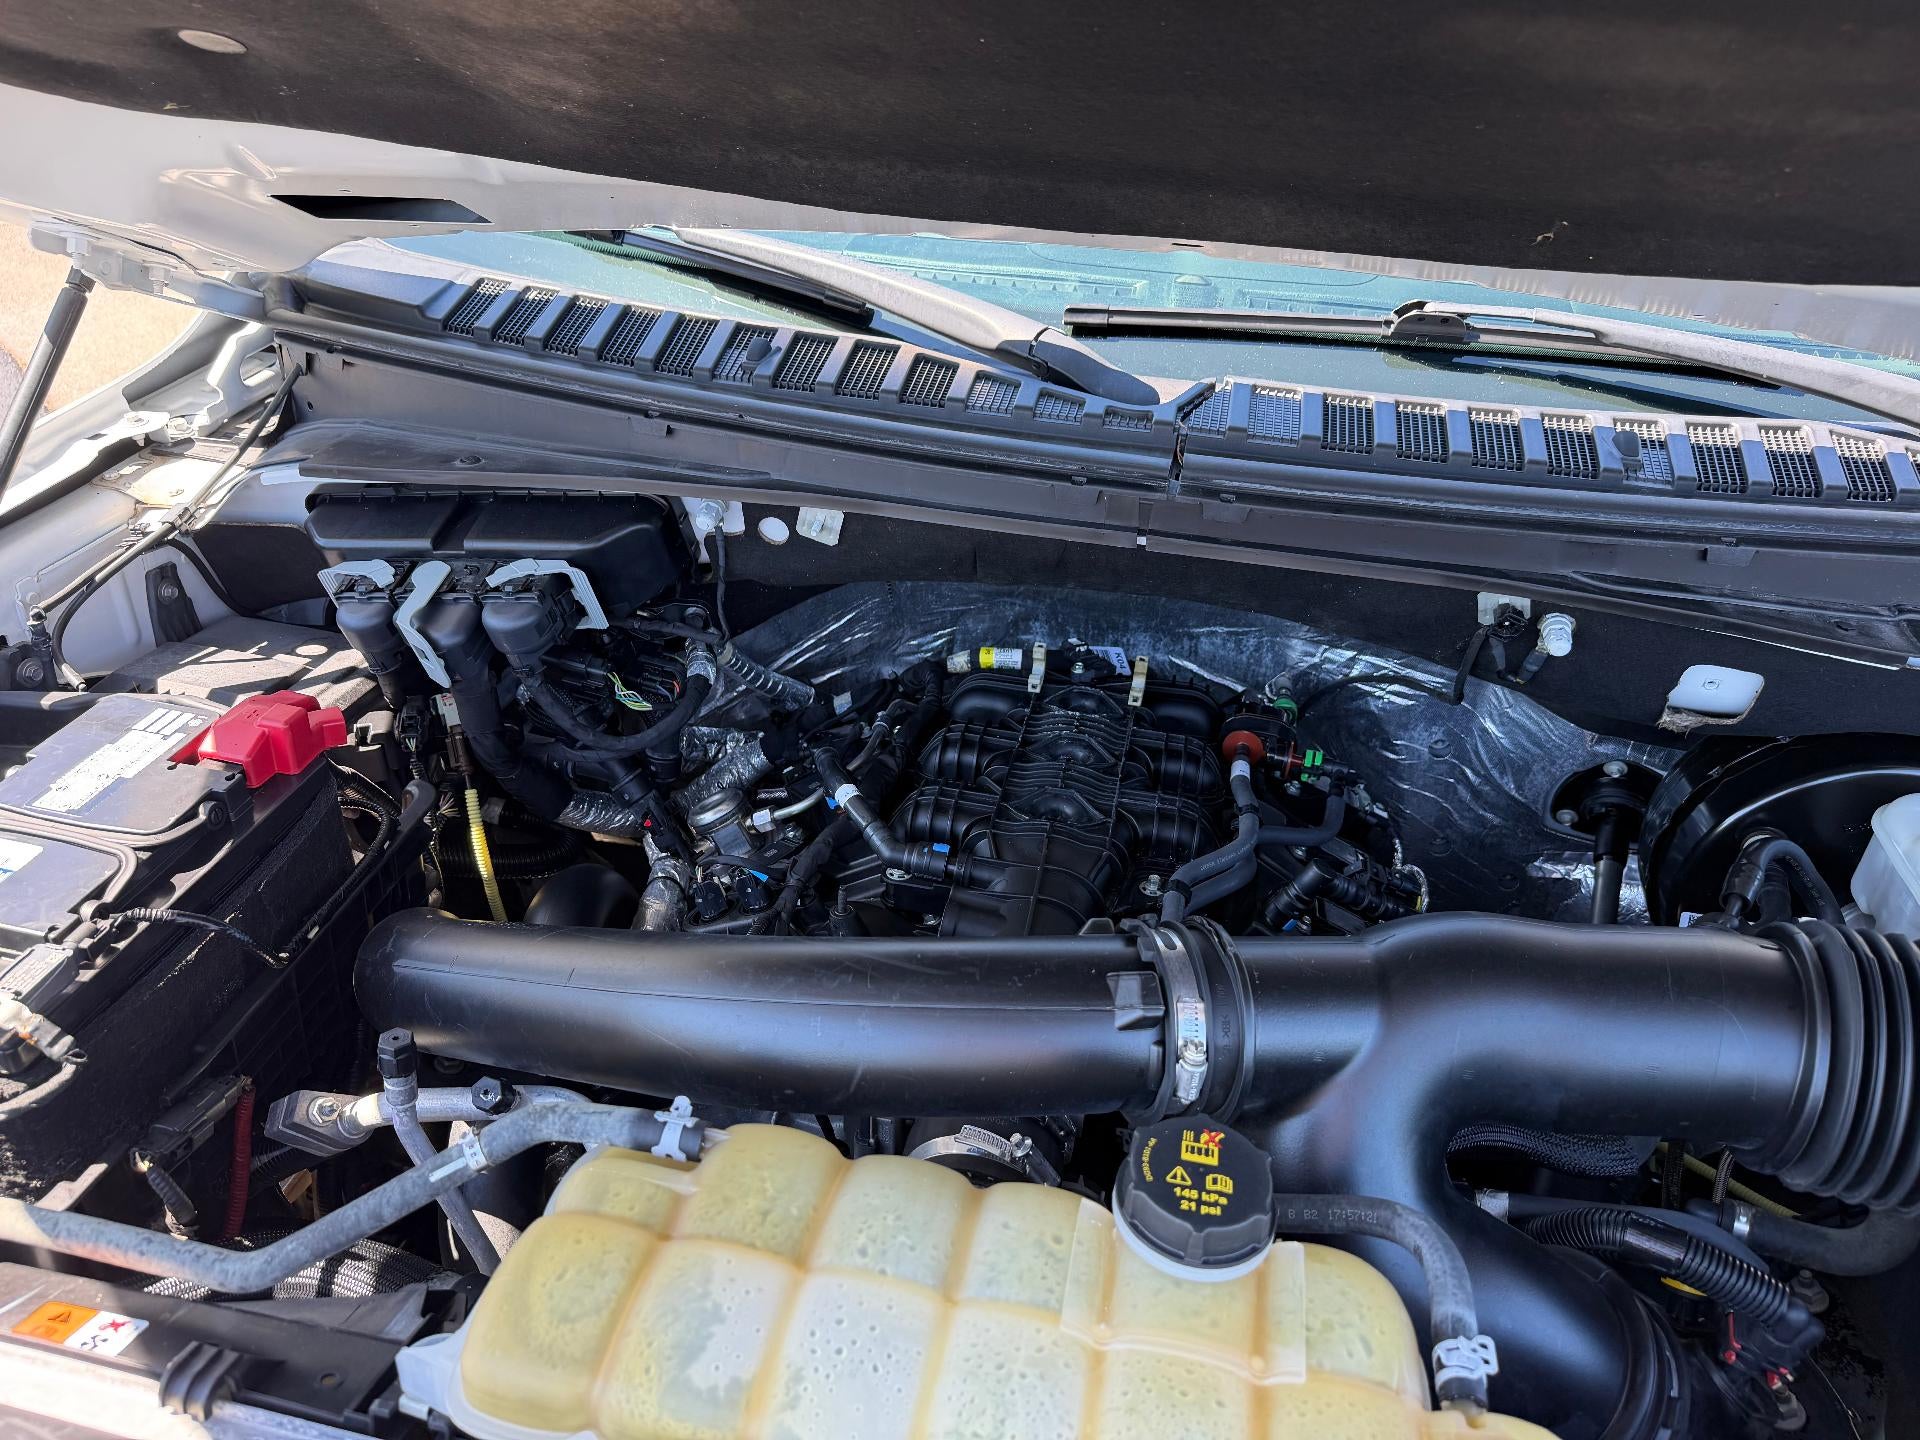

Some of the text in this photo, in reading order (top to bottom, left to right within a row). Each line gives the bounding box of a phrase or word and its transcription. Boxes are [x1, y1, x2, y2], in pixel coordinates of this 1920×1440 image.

[1114, 652, 1127, 669] K04
[1173, 1186, 1229, 1205] 145 kPa
[1179, 1200, 1222, 1216] 21 psi
